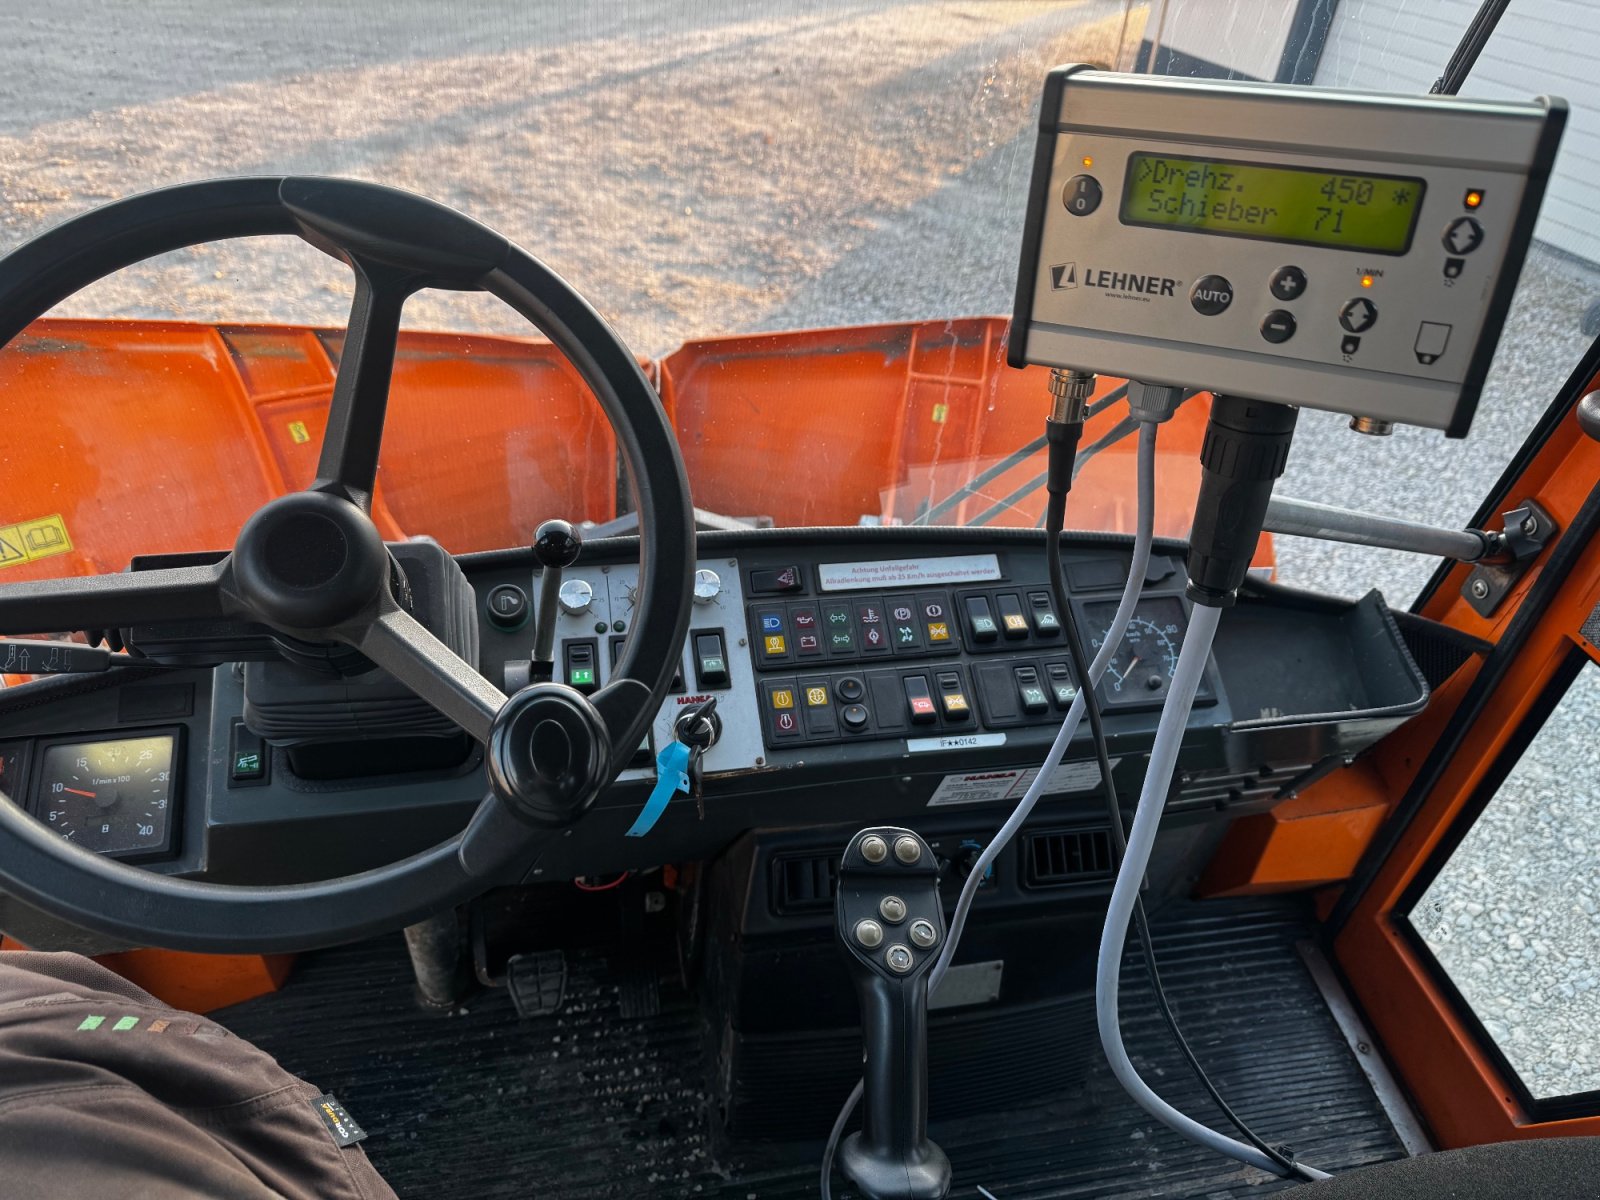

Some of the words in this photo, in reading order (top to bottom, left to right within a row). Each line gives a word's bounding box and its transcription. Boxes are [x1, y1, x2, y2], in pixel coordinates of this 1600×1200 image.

[1320, 177, 1374, 206] 450
[1147, 188, 1278, 225] Schieber
[1315, 206, 1343, 233] 71
[1105, 292, 1151, 303] www.lehner.eu
[1194, 290, 1230, 304] AUTO
[879, 564, 919, 573] Unfallgefahr
[825, 576, 871, 585] Allradlenkung
[970, 568, 996, 576] werden
[1114, 682, 1121, 692] 0
[677, 694, 711, 705] HANS
[139, 749, 153, 760] 25
[76, 757, 87, 768] 15
[52, 783, 64, 793] 10
[49, 811, 57, 821] 5
[139, 825, 153, 836] 40
